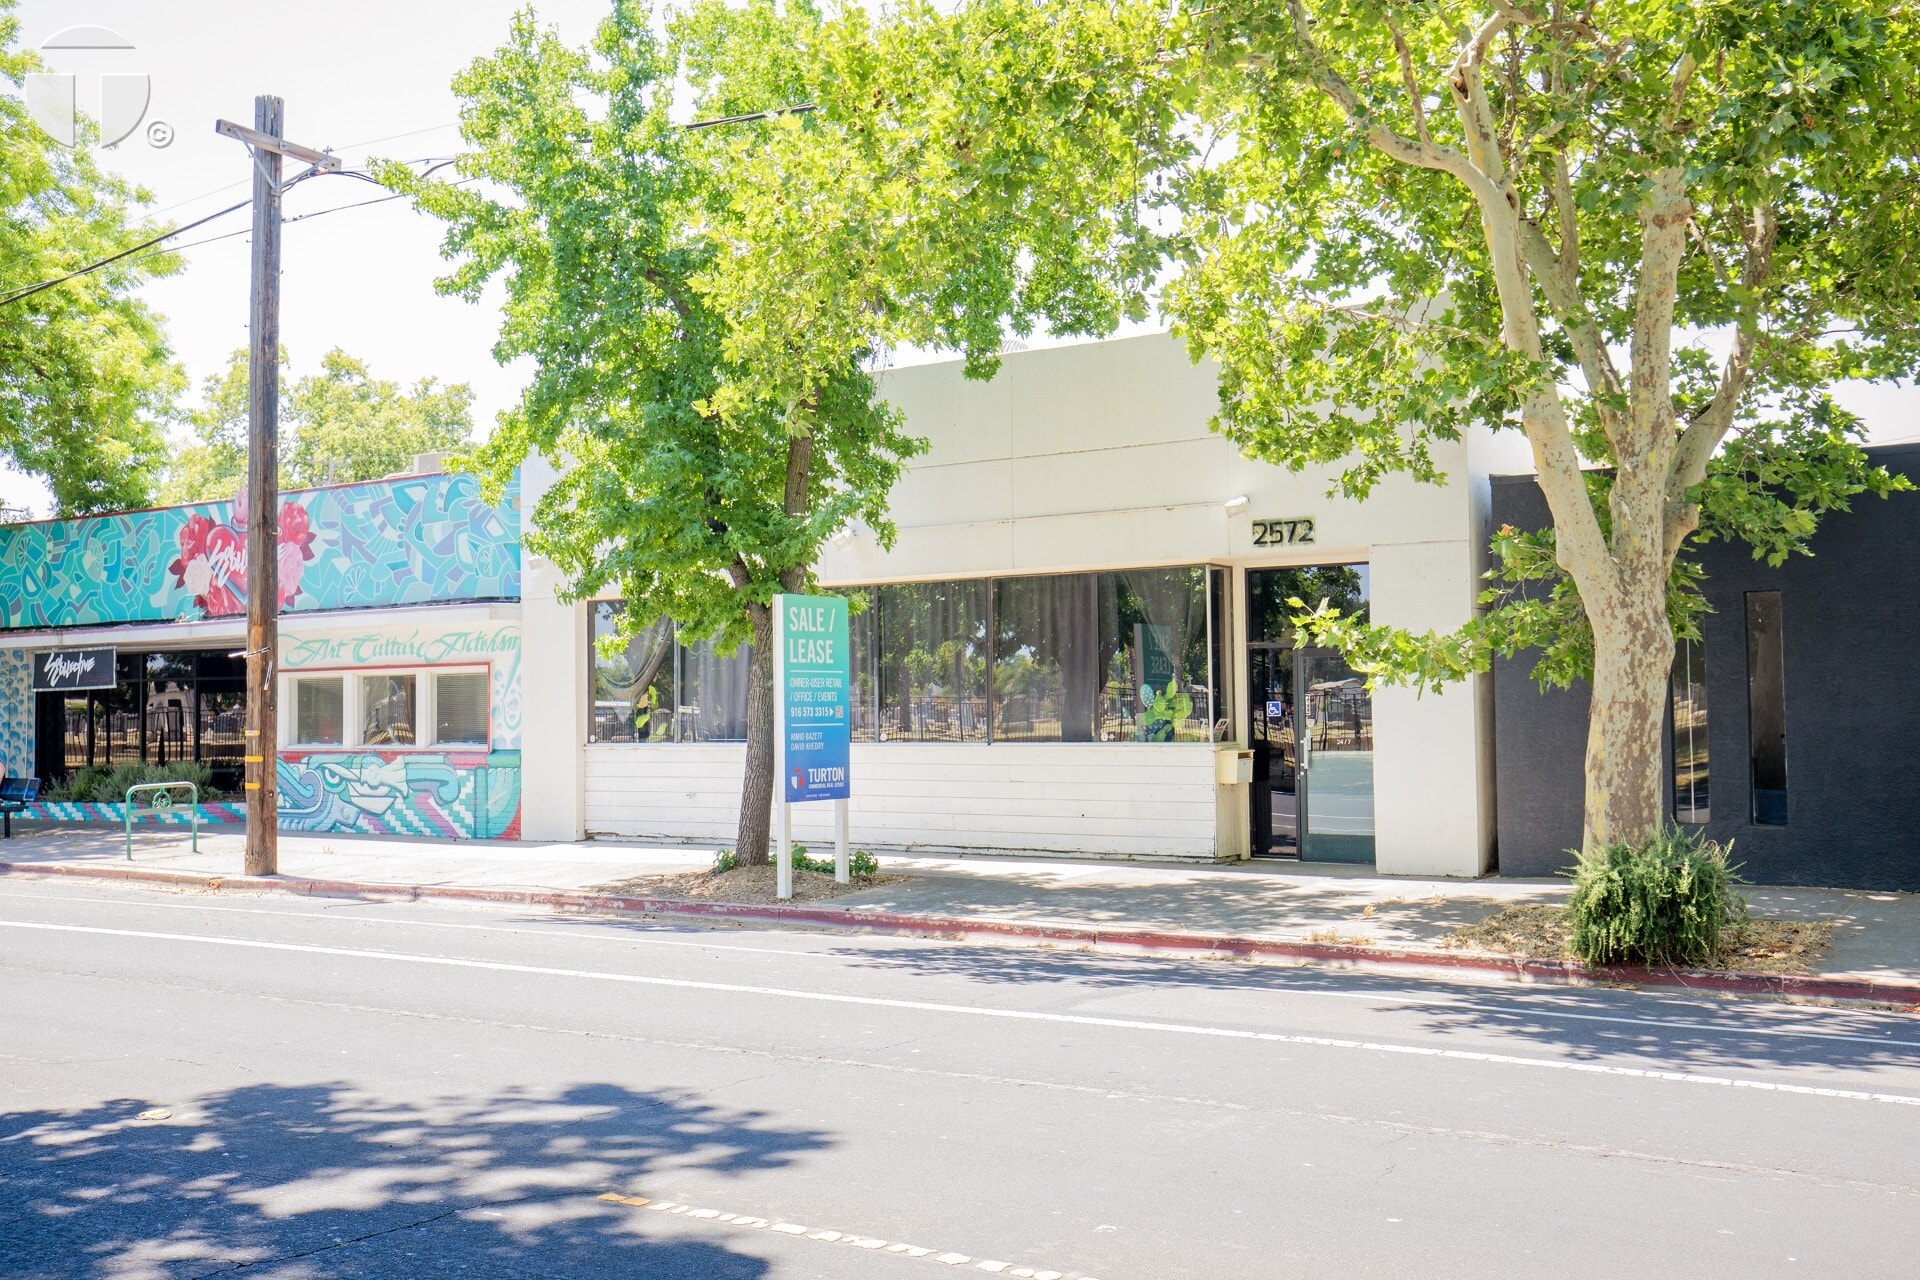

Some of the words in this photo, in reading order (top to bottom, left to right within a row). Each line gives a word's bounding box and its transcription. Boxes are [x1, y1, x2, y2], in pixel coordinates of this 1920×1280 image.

[1253, 520, 1313, 545] 2572
[790, 607, 825, 631] SALE
[829, 608, 835, 632] /
[286, 638, 348, 666] Art
[348, 628, 427, 663] Culture
[789, 638, 834, 664] LEASE
[790, 677, 825, 688] OWNER-USER
[826, 677, 842, 688] RETAIL
[793, 691, 813, 702] OFFICE
[818, 691, 838, 702] EVENTS
[790, 706, 802, 717] 916
[803, 706, 814, 717] 573
[815, 706, 829, 717] 3315
[791, 732, 804, 741] KIMIO
[805, 731, 823, 741] BAZETT
[790, 742, 804, 751] DAVID
[808, 767, 845, 783] TURTON
